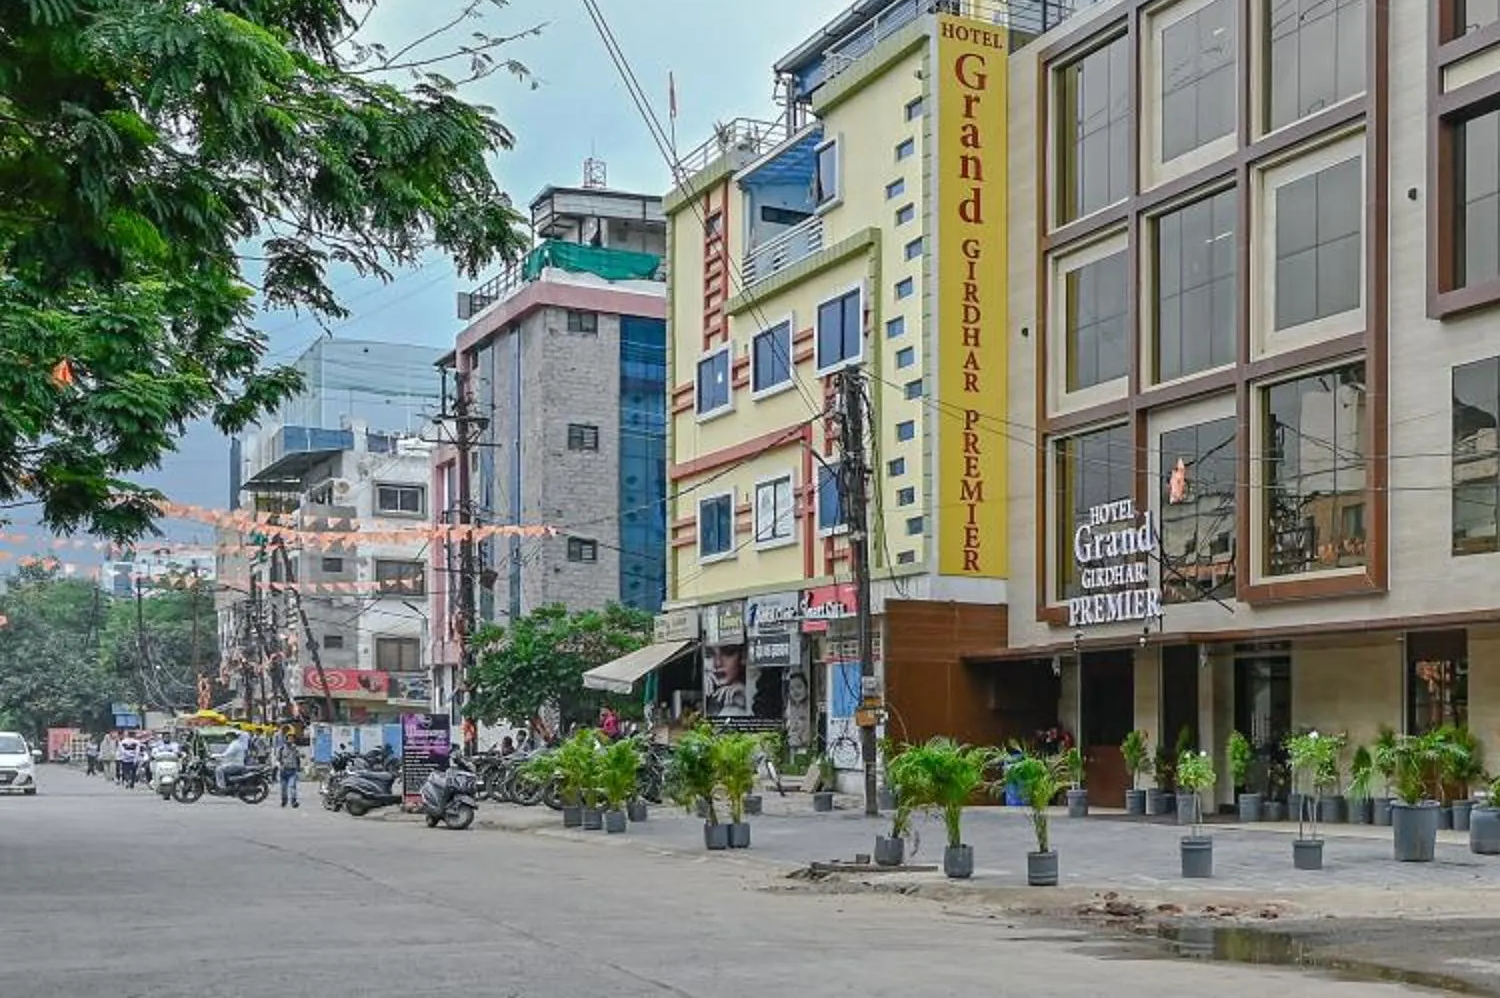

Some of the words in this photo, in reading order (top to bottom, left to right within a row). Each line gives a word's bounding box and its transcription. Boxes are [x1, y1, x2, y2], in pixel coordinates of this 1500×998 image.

[941, 21, 1003, 49] HOTEL
[954, 53, 988, 225] Grand
[961, 239, 982, 393] GIRDHAR
[959, 409, 984, 572] PREMIER
[1089, 499, 1135, 525] HOTEL
[1074, 510, 1155, 563] Grand
[1081, 562, 1146, 589] GIRDHAR
[1068, 588, 1165, 627] PREMIER
